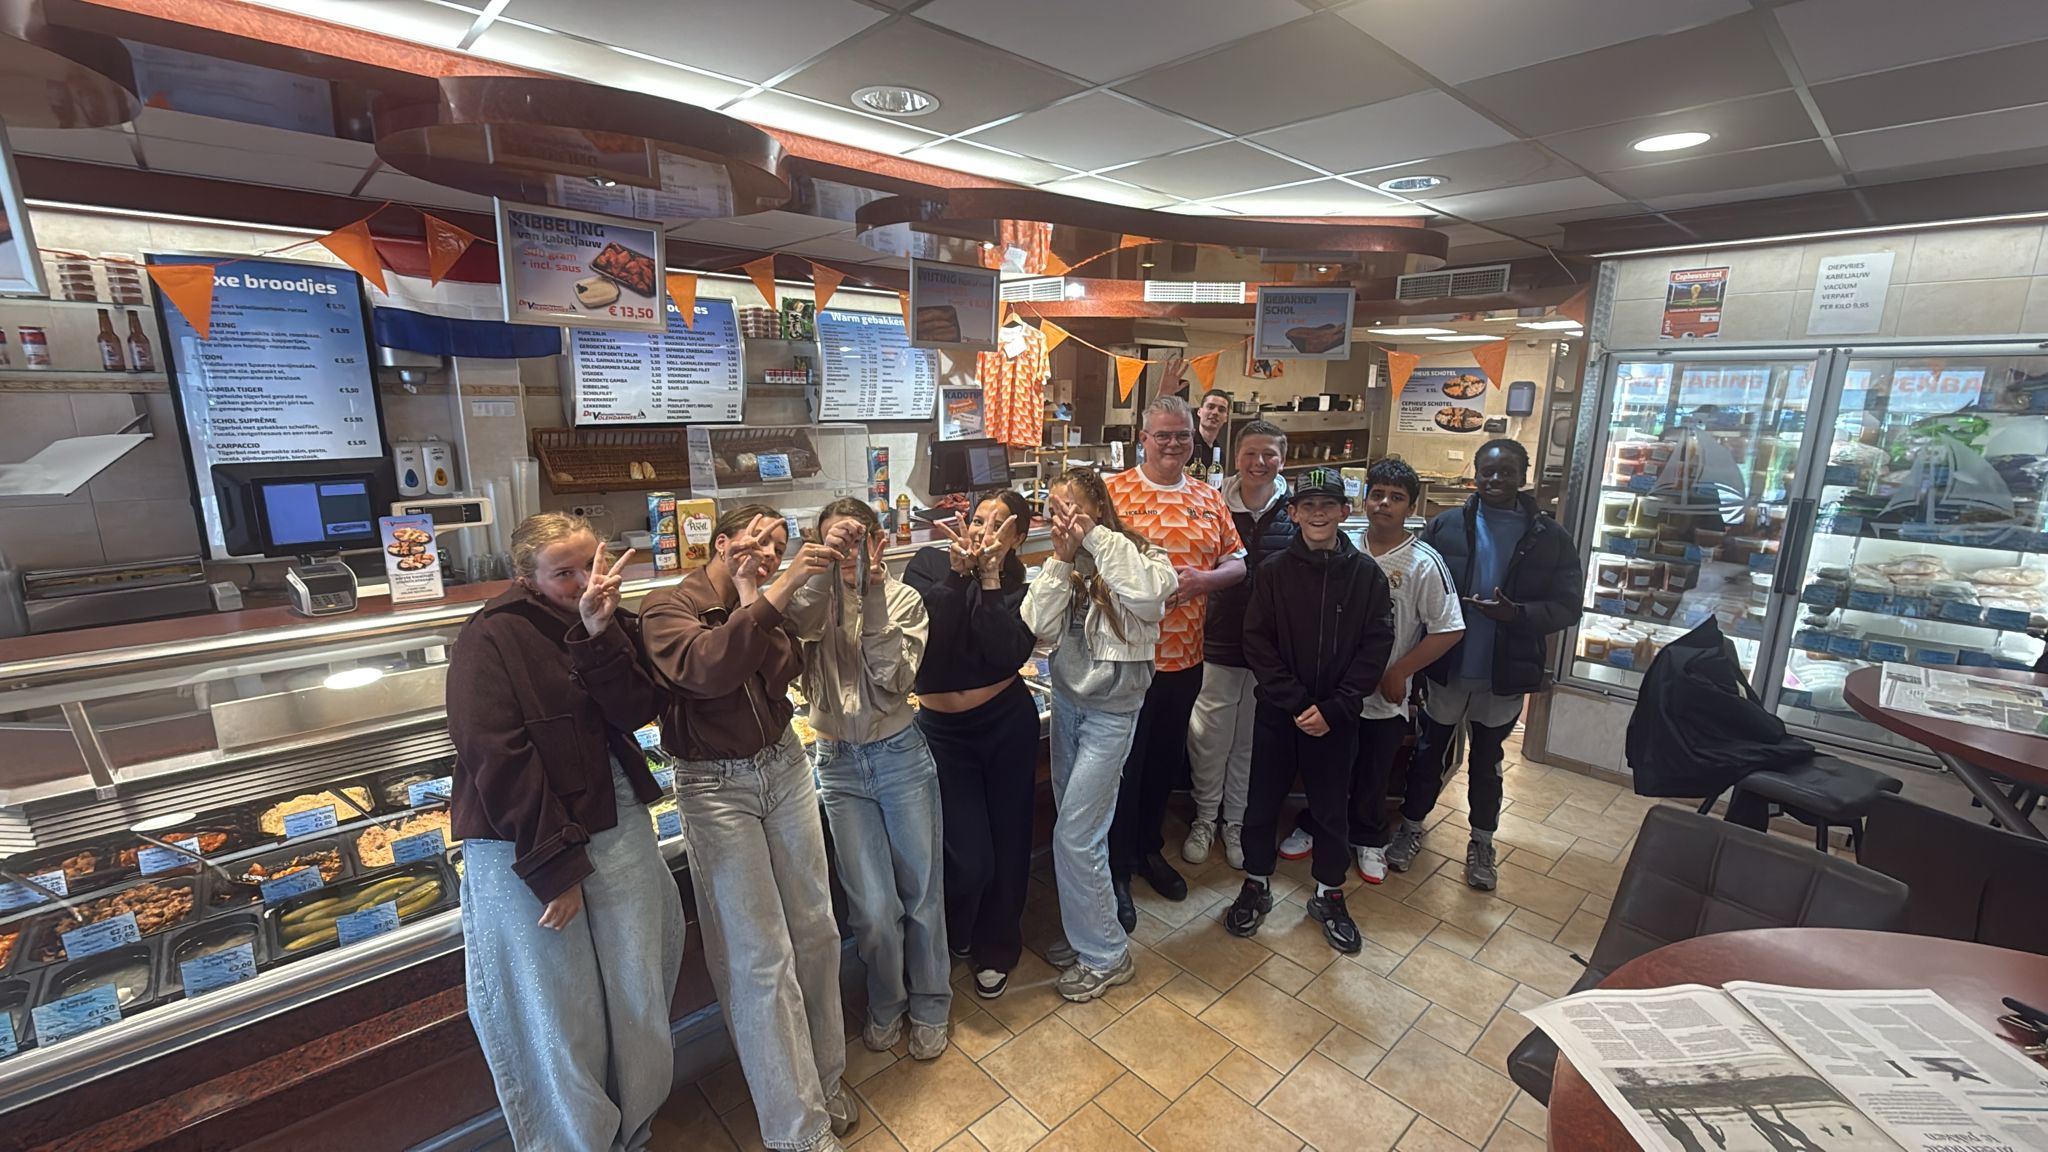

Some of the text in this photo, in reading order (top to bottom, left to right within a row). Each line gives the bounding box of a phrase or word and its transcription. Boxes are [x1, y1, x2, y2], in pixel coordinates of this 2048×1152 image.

[512, 213, 604, 237] KIBBELING
[517, 232, 602, 249] van kabeljauw
[547, 251, 577, 262] gram
[556, 263, 582, 273] saus
[1828, 262, 1865, 271] DIEPVRIES
[1825, 272, 1871, 280] KABELJAUW
[213, 274, 338, 296] xe broodjes
[1822, 292, 1856, 300] VERPAKT
[609, 306, 654, 320] € 13,50
[1264, 306, 1296, 315] SCHOL
[830, 312, 905, 326] Warm gebakken
